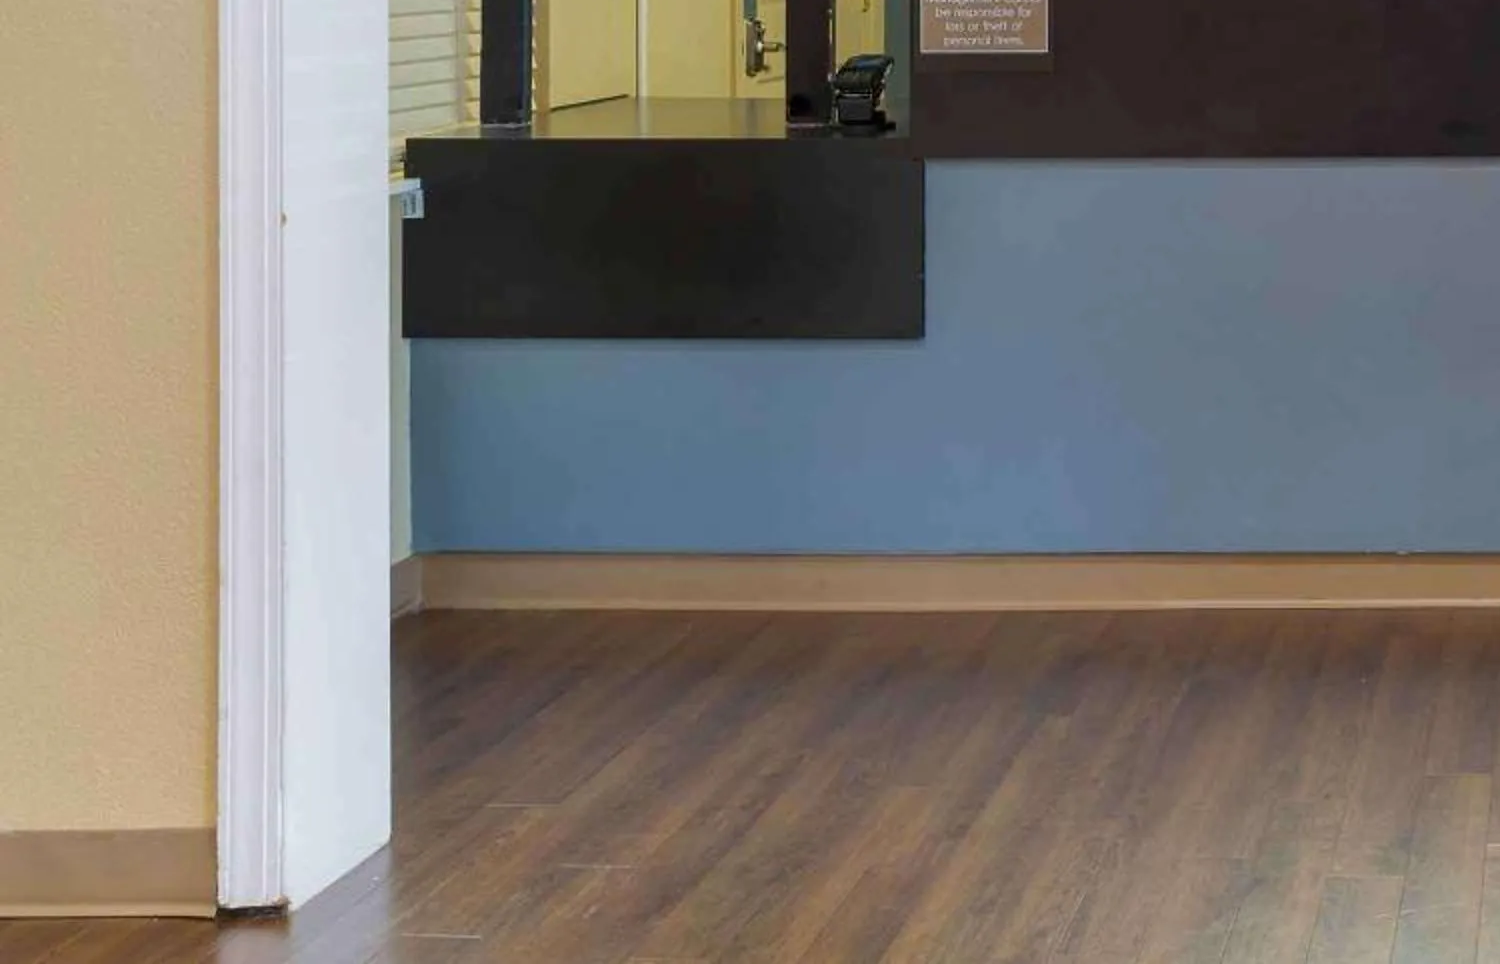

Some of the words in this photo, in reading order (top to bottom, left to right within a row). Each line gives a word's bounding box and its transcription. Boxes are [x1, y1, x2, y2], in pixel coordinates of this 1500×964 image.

[935, 6, 951, 18] be
[953, 6, 1014, 19] responsible
[1017, 6, 1032, 18] for
[967, 21, 979, 32] or
[983, 20, 1007, 32] theft
[1011, 20, 1023, 32] of
